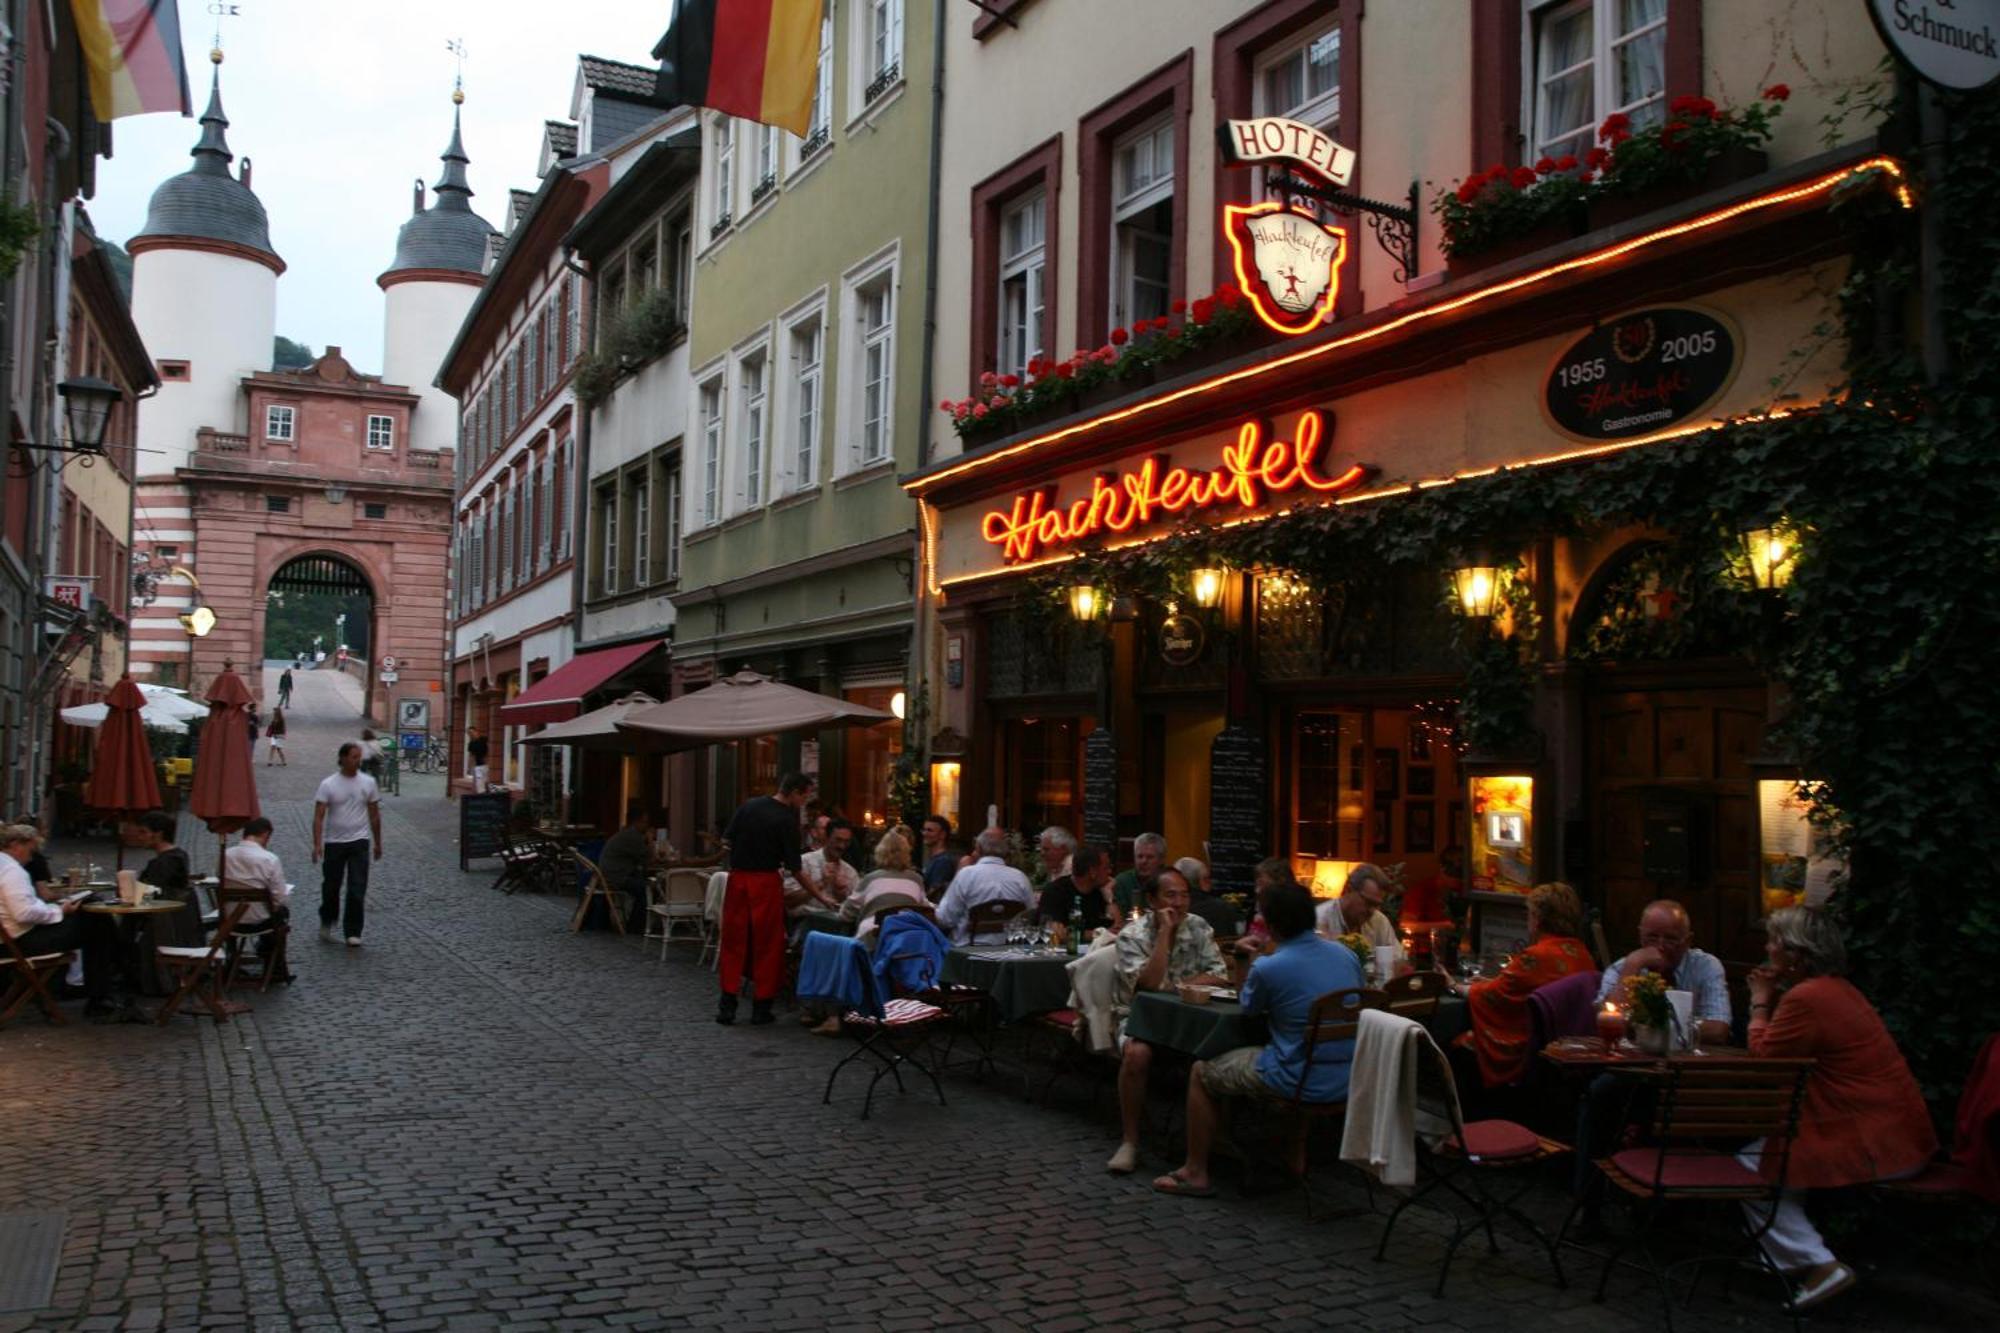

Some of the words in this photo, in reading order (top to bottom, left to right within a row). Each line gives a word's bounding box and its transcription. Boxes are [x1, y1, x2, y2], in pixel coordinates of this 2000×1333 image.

[1894, 0, 1997, 58] Schmuck
[1236, 121, 1345, 179] HOTEL
[1558, 358, 1606, 387] 1955
[1661, 330, 1716, 363] 2005
[1601, 408, 1673, 432] Gastronomie
